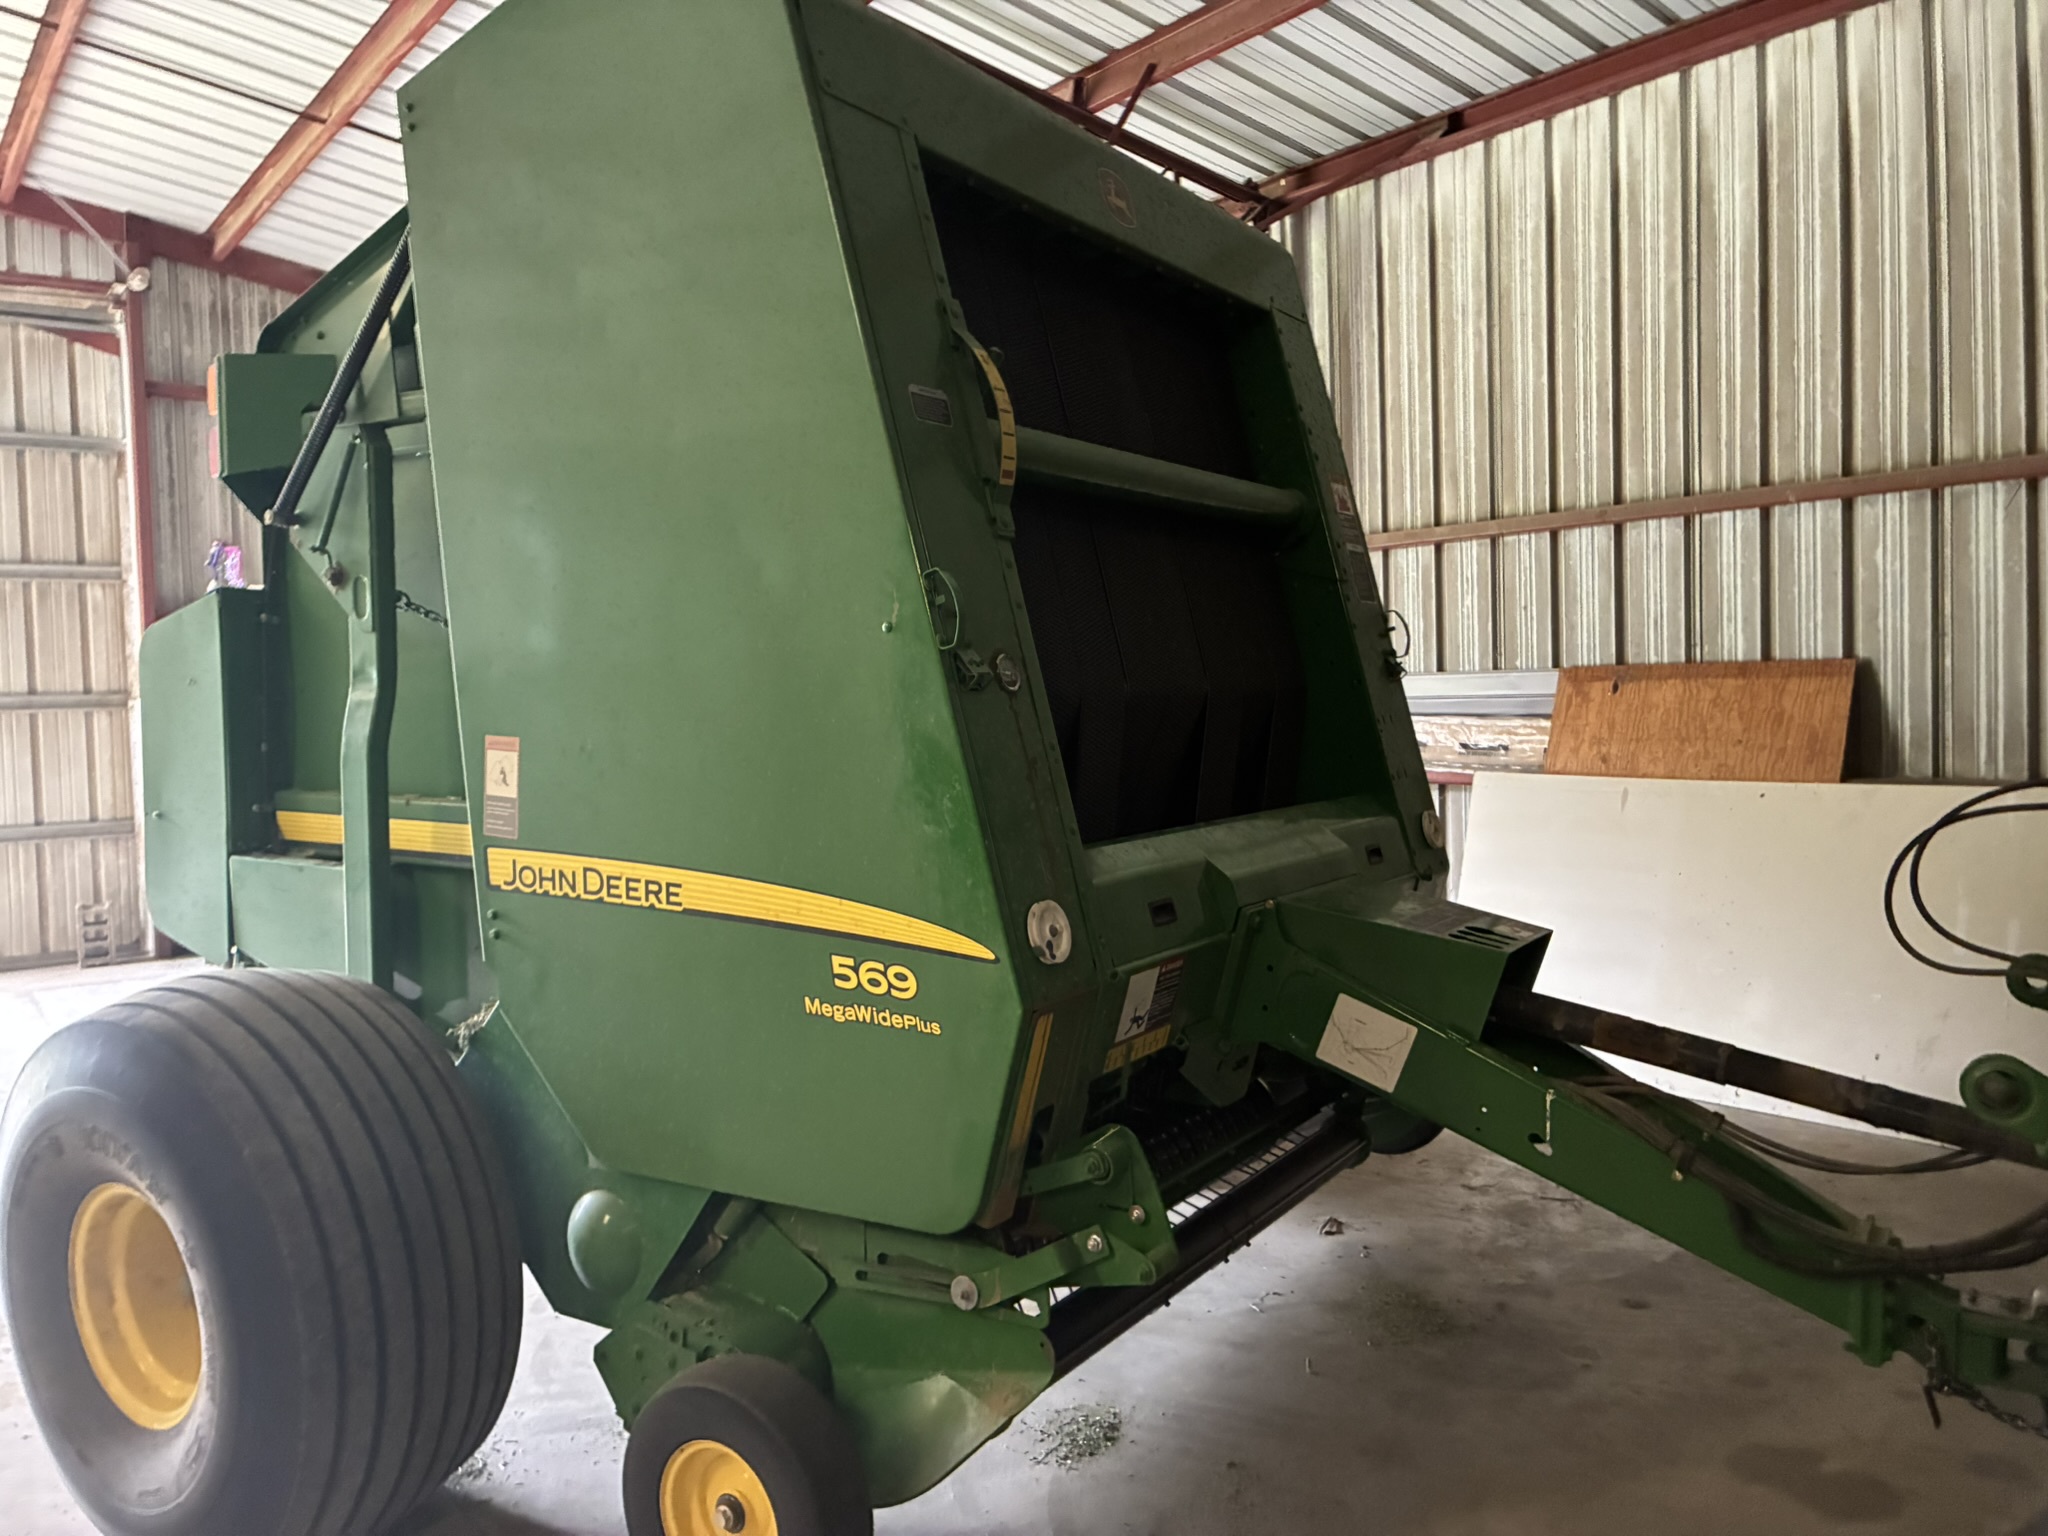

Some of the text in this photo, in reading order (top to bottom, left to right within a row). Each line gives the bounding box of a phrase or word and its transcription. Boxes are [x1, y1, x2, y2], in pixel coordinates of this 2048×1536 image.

[503, 859, 683, 907] JOHN DEERE
[830, 953, 919, 1001] 569
[803, 995, 943, 1036] MegaWidePlus
